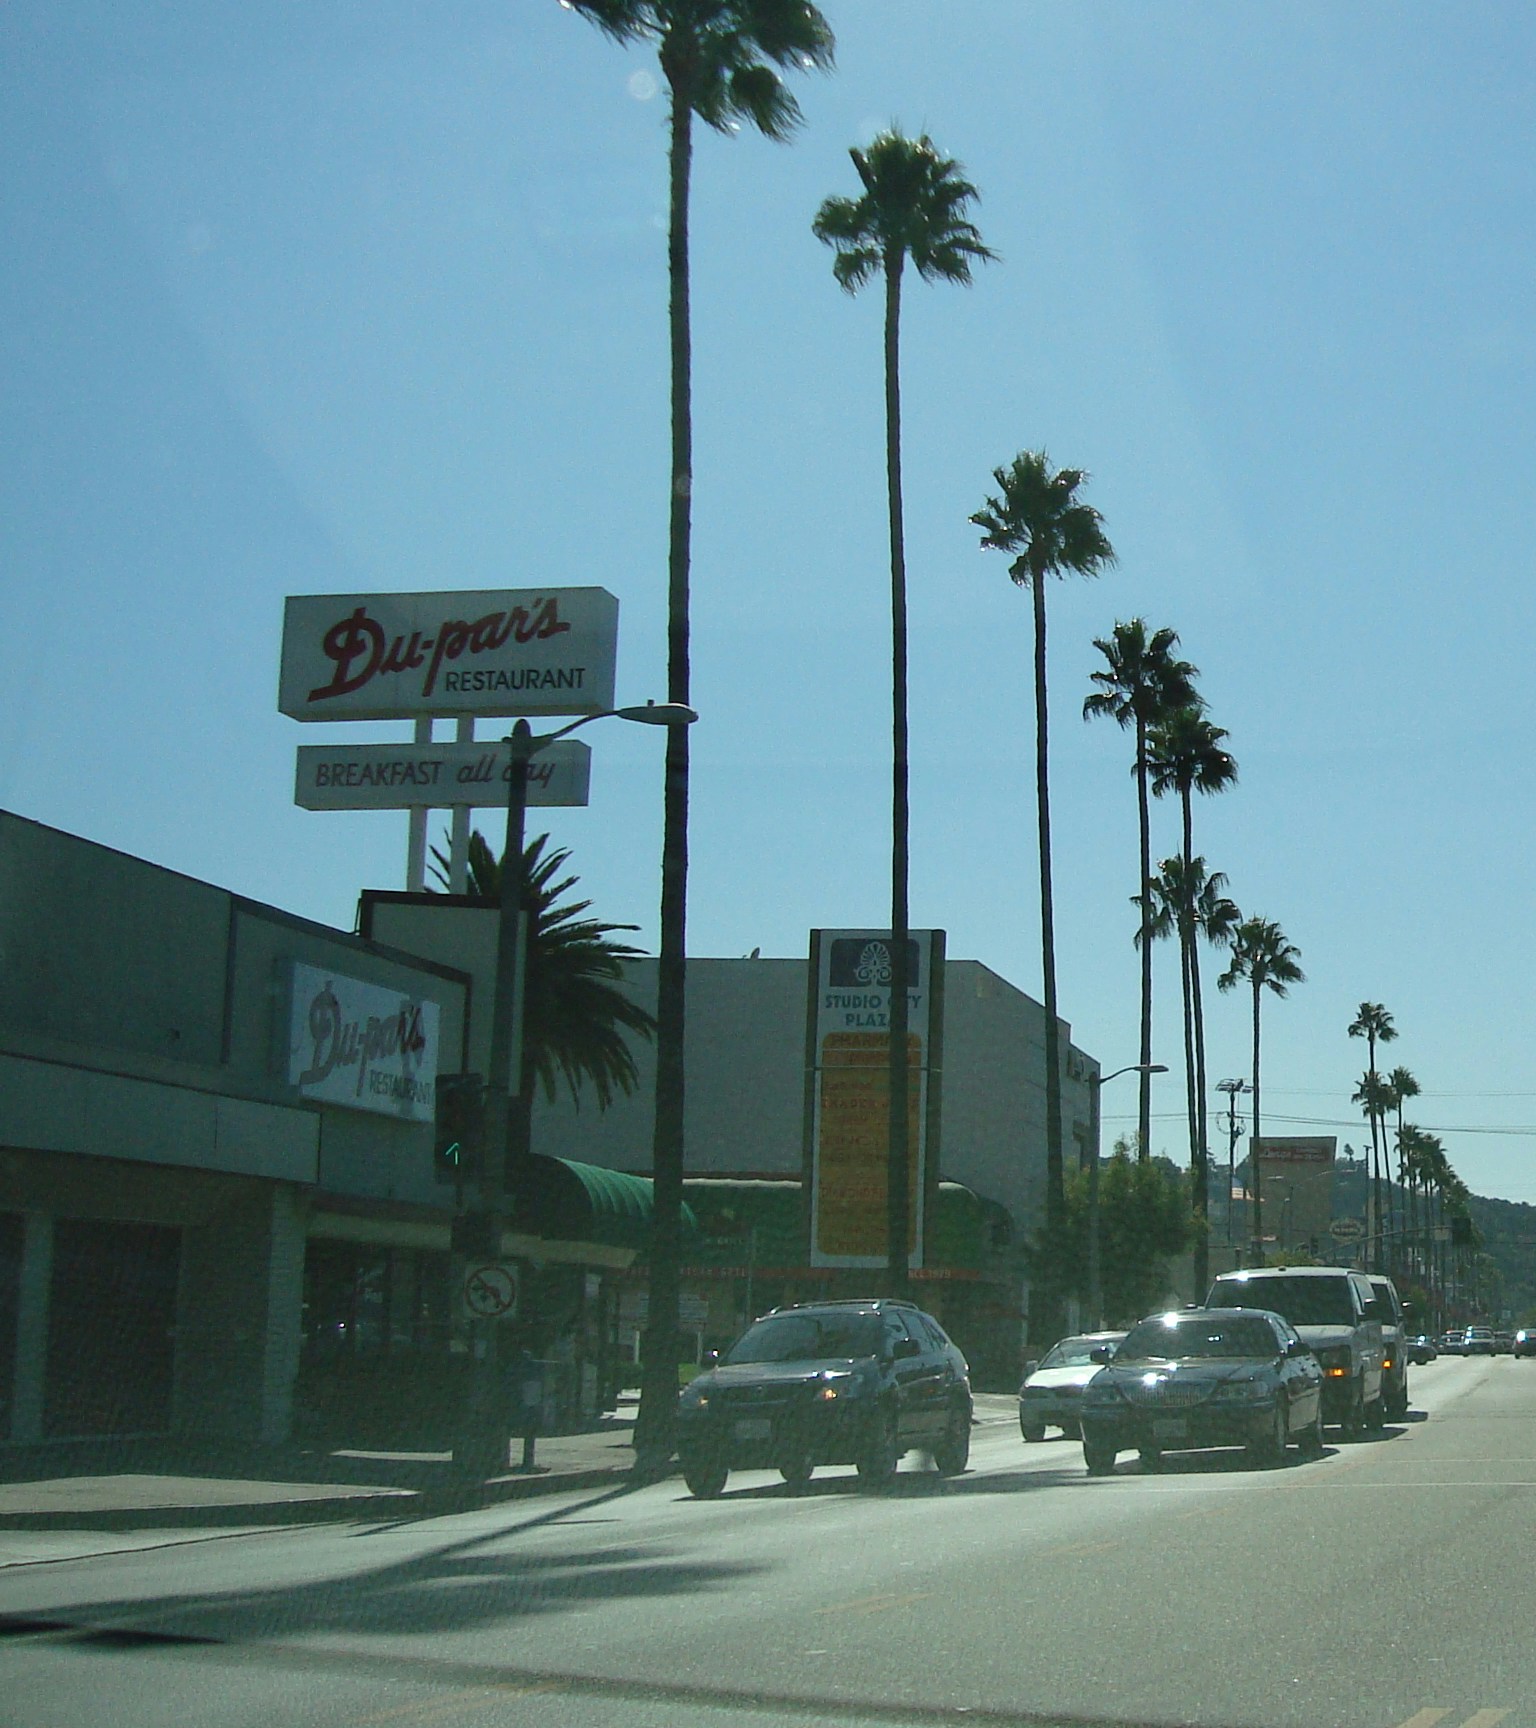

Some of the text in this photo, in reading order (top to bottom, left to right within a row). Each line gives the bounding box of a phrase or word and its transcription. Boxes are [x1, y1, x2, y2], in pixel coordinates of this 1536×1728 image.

[308, 597, 571, 702] Du-par's
[445, 668, 586, 692] RESTAURANT
[315, 761, 444, 787] BREAKFAST
[456, 753, 497, 784] all
[825, 994, 882, 1009] STUDIO
[845, 1013, 890, 1027] PLAZ
